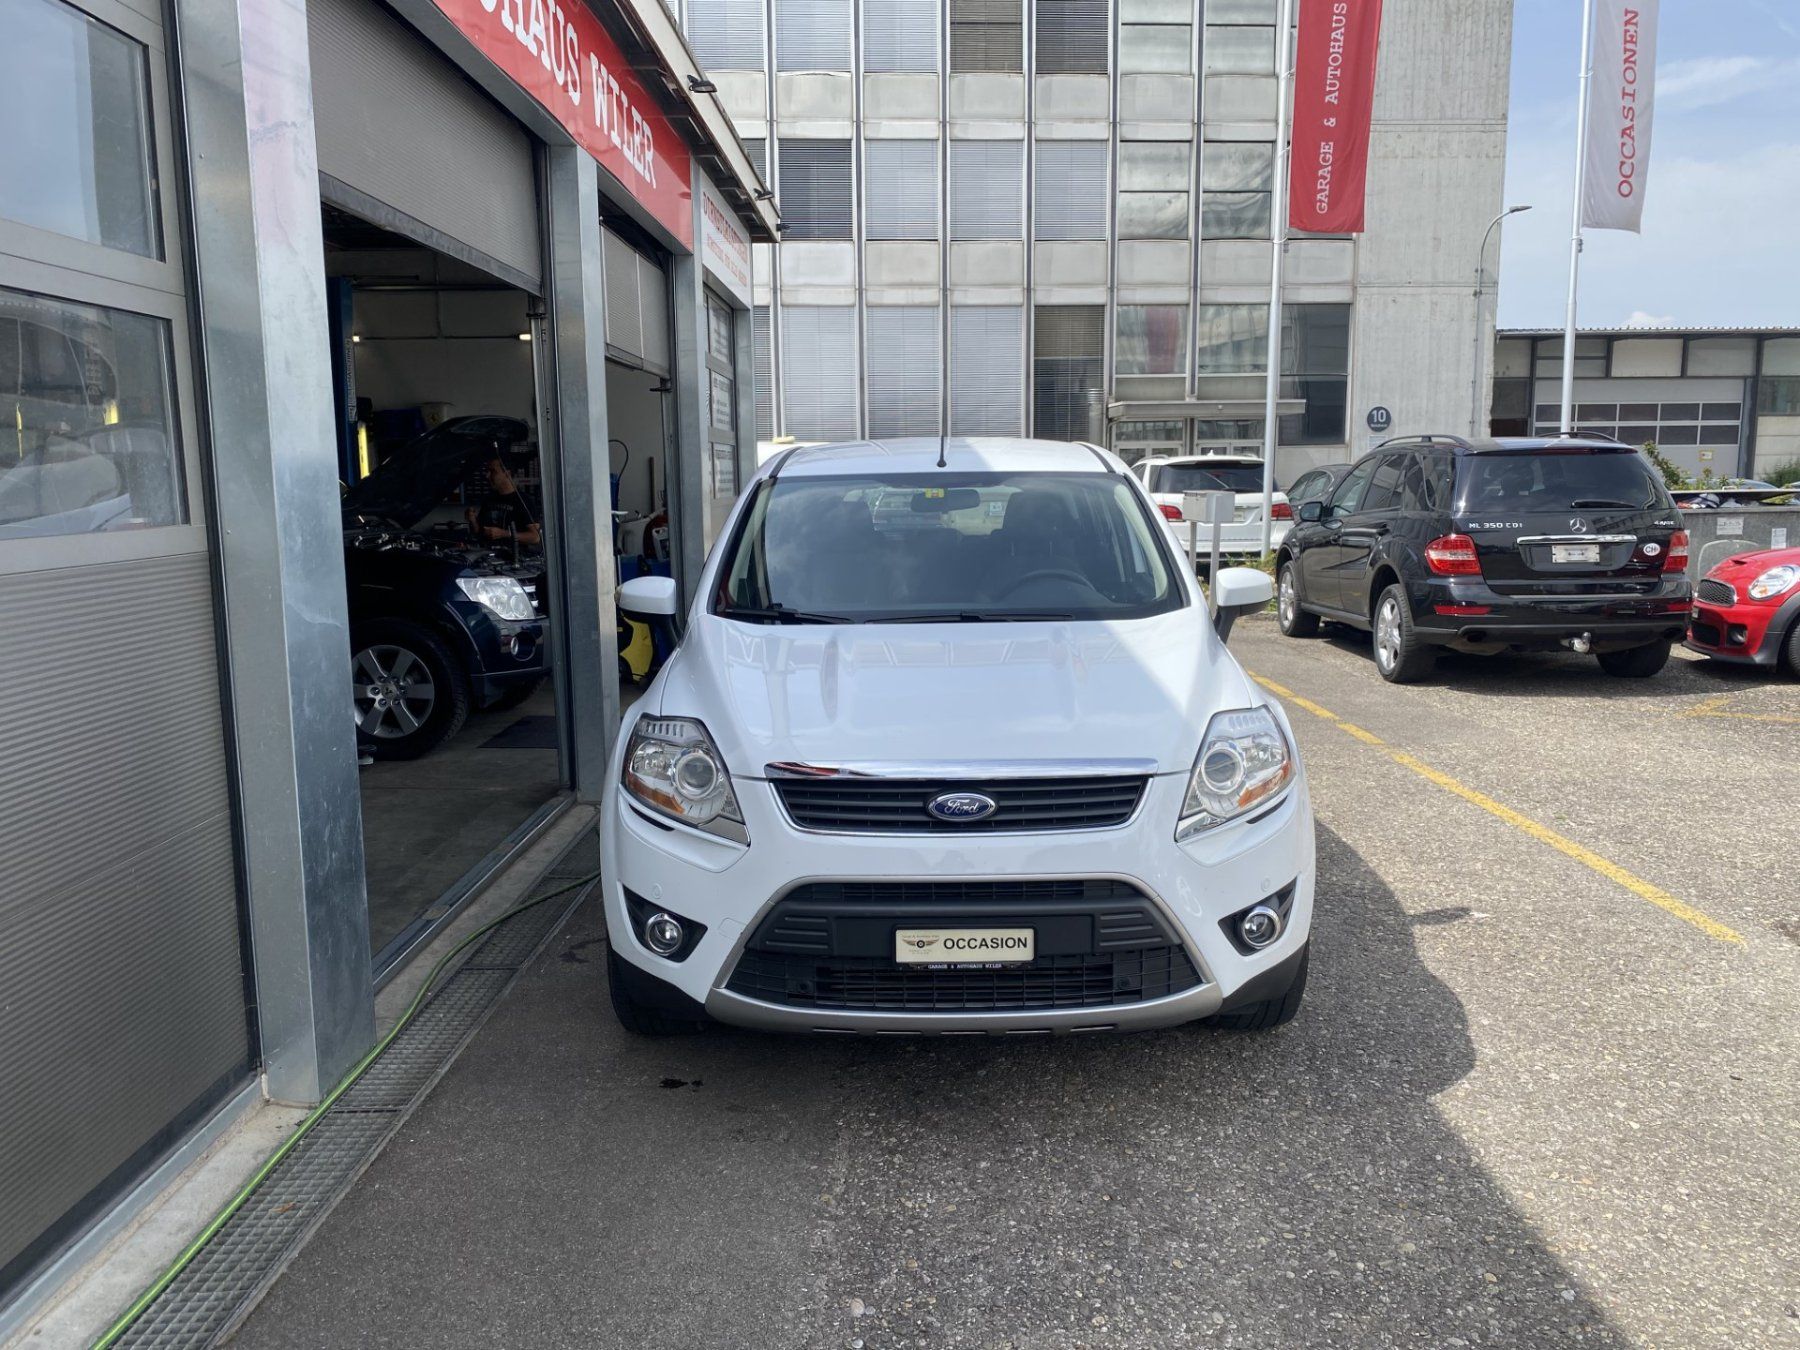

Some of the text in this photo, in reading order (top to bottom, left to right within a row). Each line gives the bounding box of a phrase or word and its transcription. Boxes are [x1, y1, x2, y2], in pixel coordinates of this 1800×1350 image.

[589, 51, 657, 189] WILER
[1316, 2, 1348, 214] GARAGE & AUTOHAUS
[1617, 7, 1640, 199] OCCASIONEN
[1371, 409, 1387, 423] 10
[943, 799, 980, 814] Ford
[943, 936, 1028, 950] OCCASION
